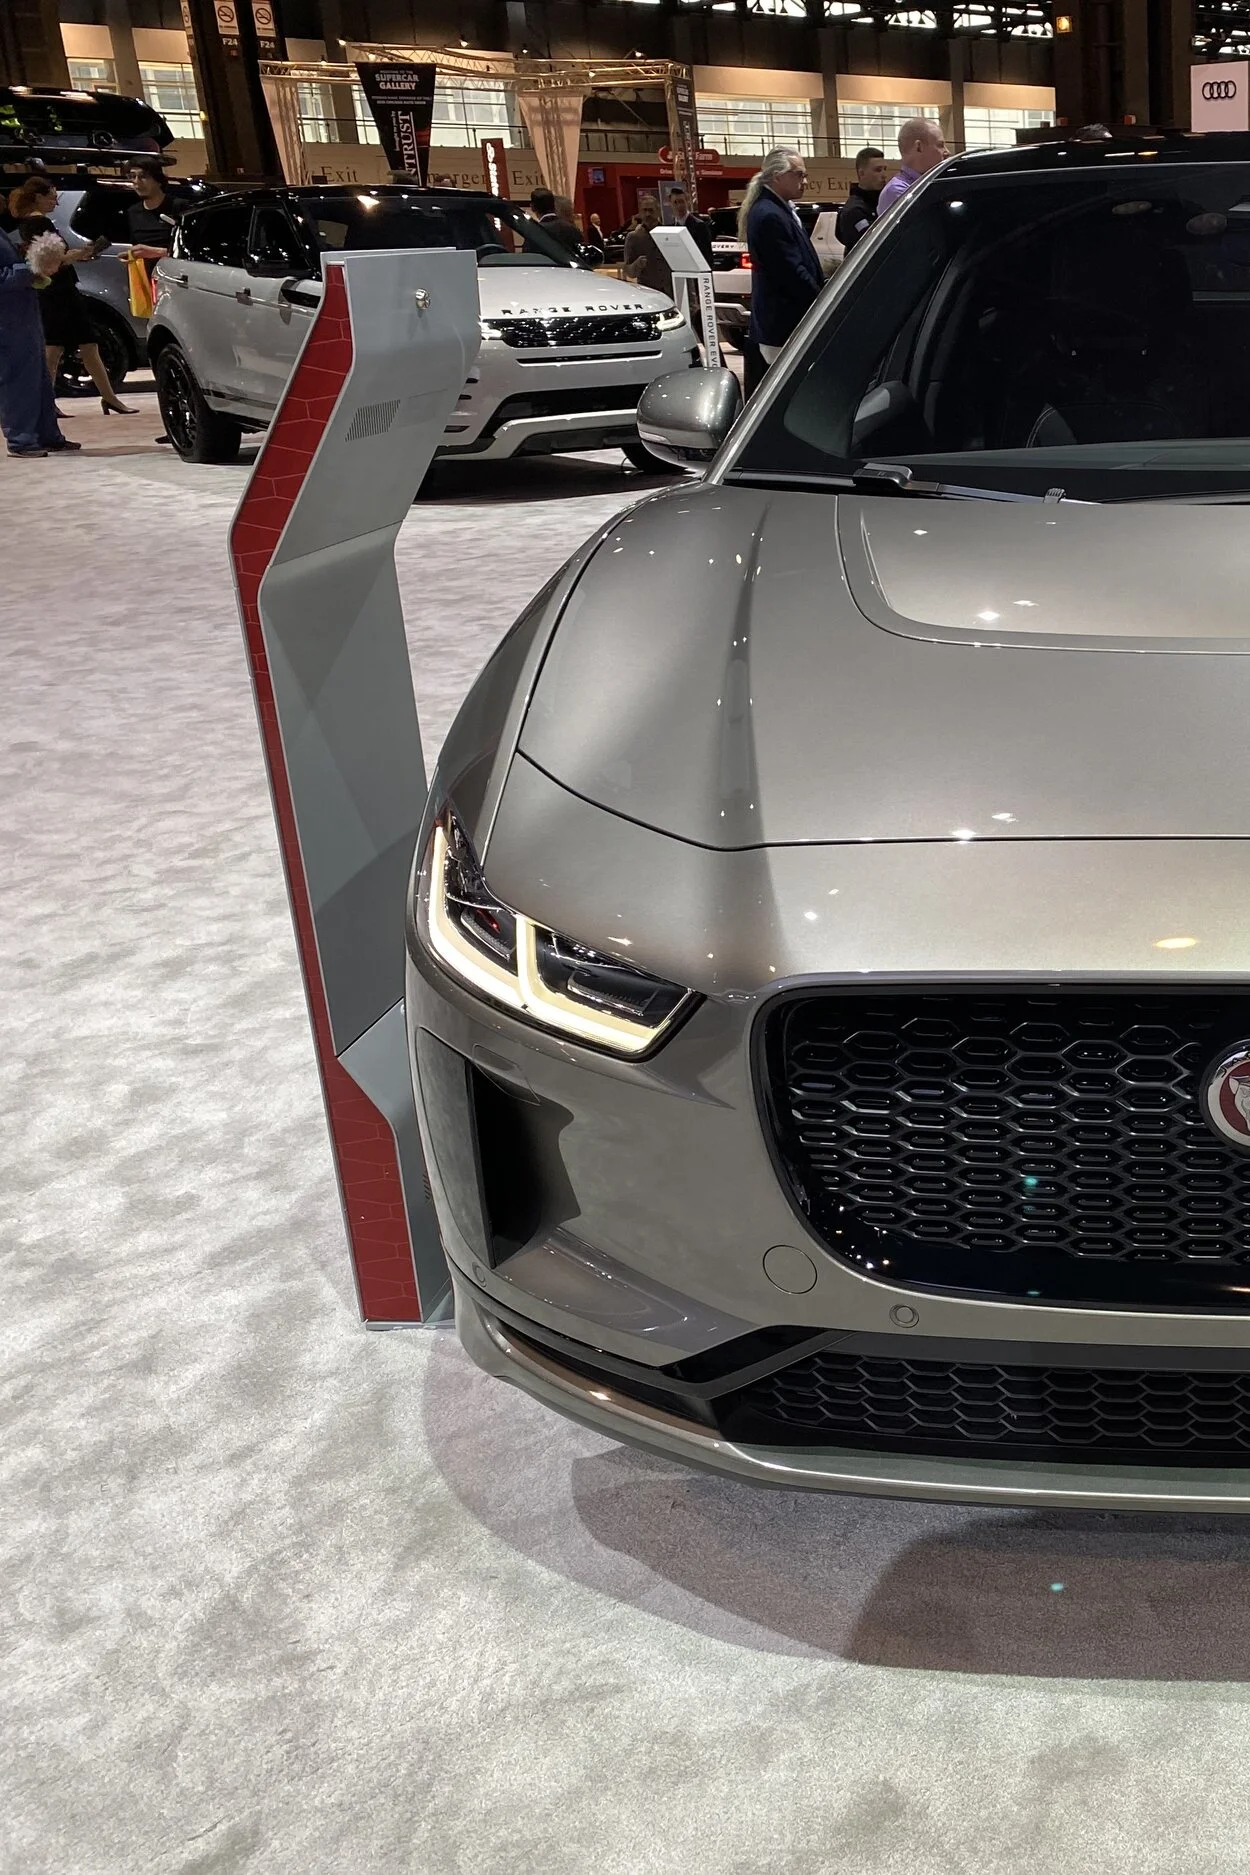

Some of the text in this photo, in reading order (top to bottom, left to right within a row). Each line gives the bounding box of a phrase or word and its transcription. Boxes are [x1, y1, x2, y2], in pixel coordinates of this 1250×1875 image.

[222, 38, 238, 46] F24
[375, 74, 420, 82] SUPERCAR
[379, 82, 416, 90] GALLERY
[321, 166, 358, 182] Exit
[703, 277, 713, 312] RANGE
[501, 303, 645, 315] RANGE ROVER
[706, 314, 716, 347] ROVER
